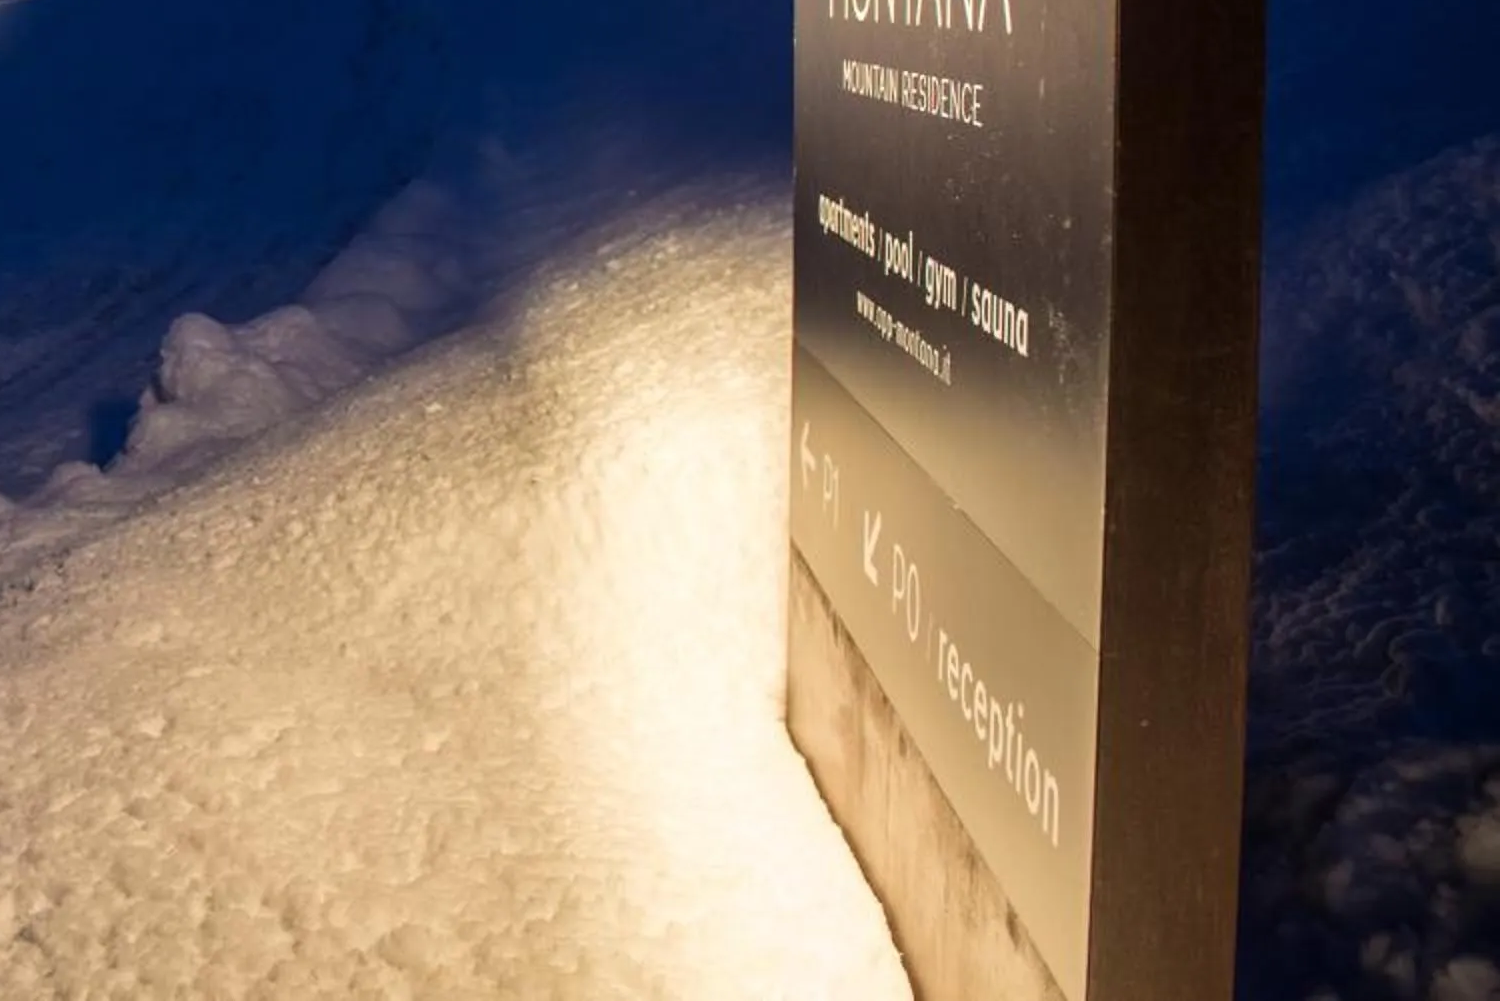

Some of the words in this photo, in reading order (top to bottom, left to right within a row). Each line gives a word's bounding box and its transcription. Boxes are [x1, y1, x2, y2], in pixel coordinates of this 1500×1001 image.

[843, 58, 899, 103] MOUNTAIN
[901, 70, 983, 128] RESIDENCE
[818, 193, 875, 258] apartments
[884, 230, 913, 283] pool
[925, 255, 957, 311] gym
[971, 282, 1029, 358] sauna
[938, 626, 1061, 849] reception
